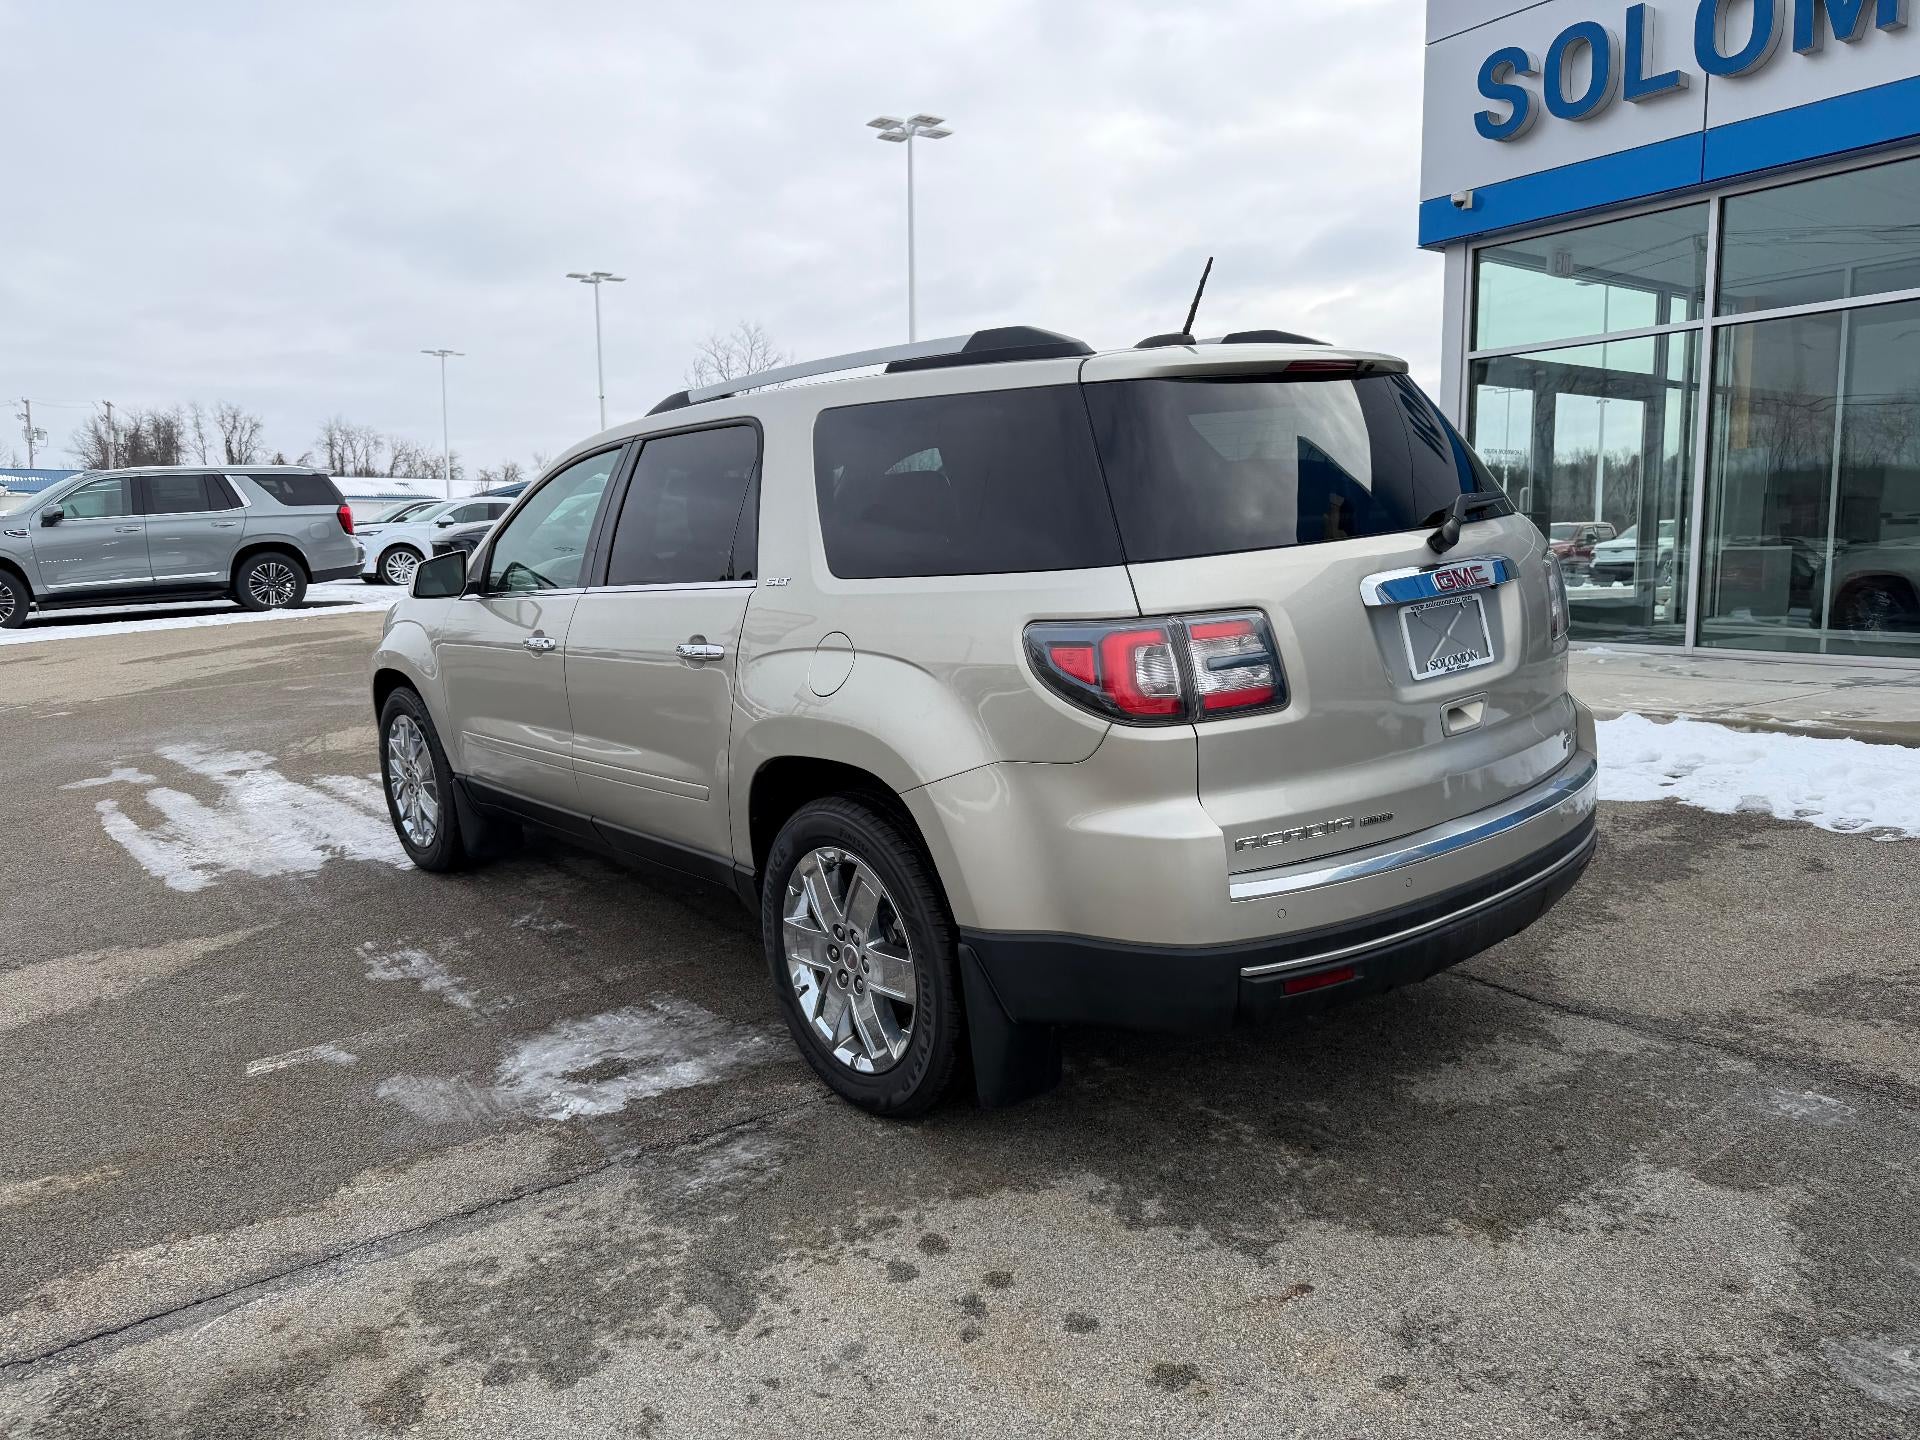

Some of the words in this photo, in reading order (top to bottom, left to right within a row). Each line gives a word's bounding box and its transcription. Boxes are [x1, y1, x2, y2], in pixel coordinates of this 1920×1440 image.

[766, 577, 791, 587] SLT
[1436, 565, 1488, 591] GMC
[1429, 650, 1478, 671] SOLOMON
[1235, 816, 1354, 851] ACADIA
